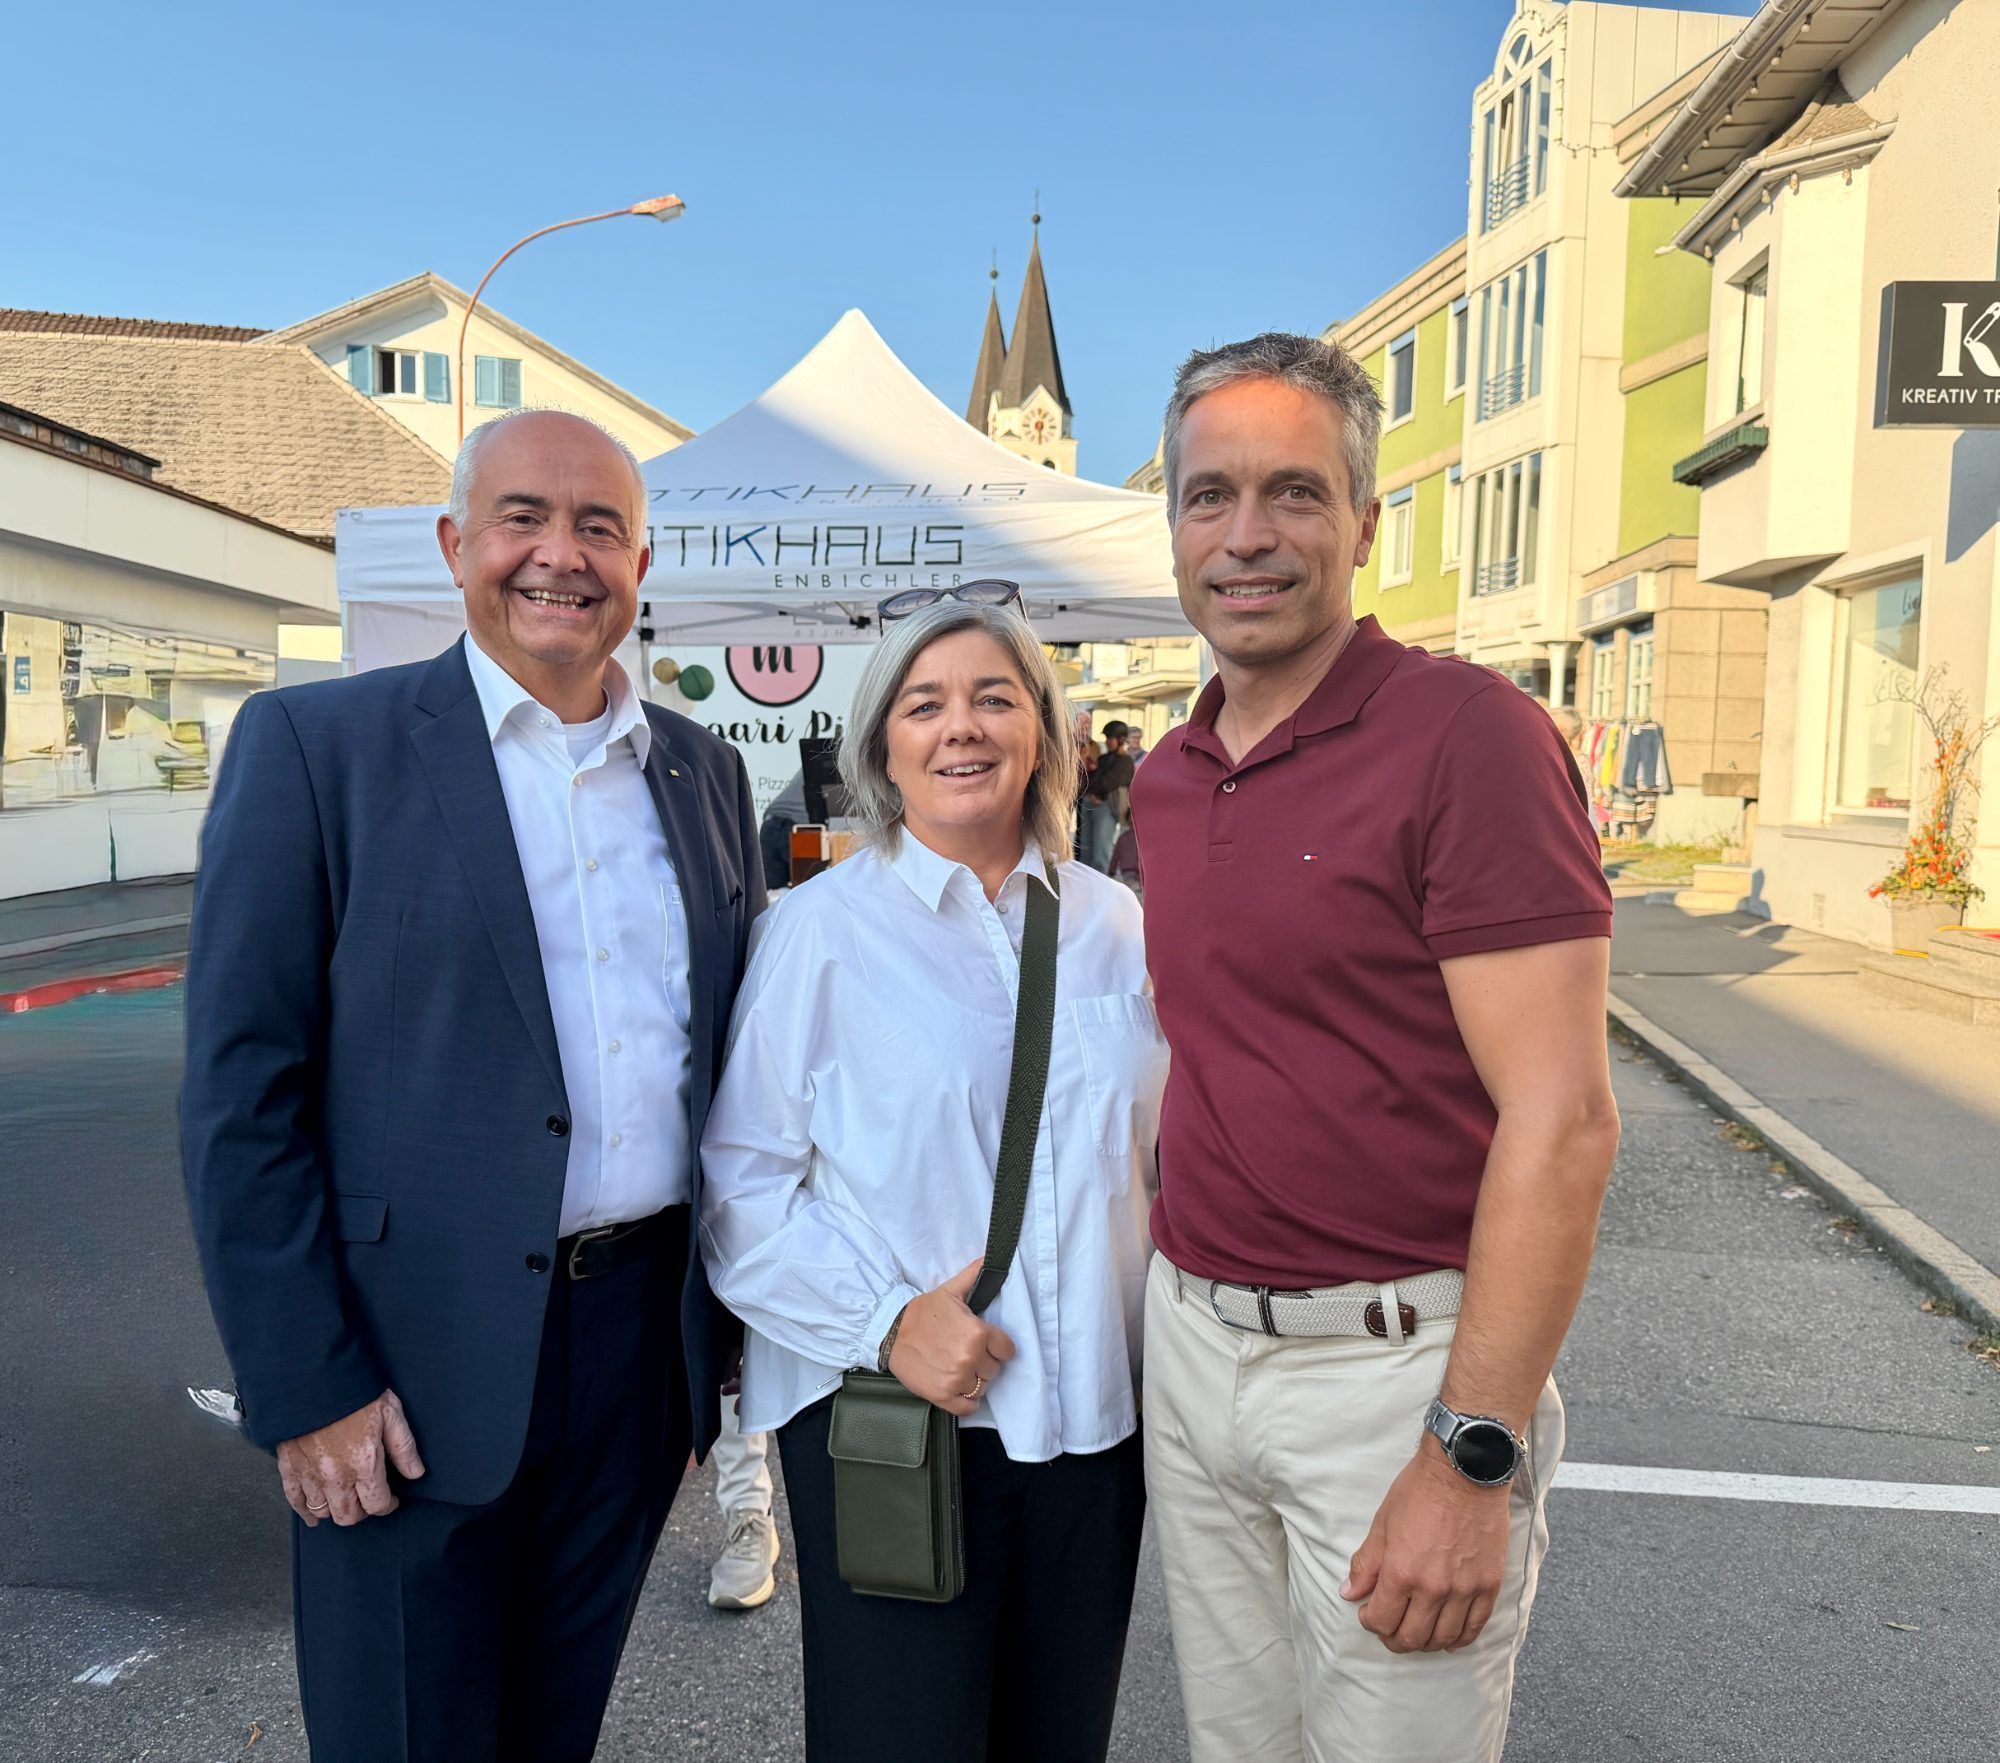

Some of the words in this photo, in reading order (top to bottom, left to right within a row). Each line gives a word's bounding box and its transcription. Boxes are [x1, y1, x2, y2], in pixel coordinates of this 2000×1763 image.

[1902, 388, 1978, 404] KREATIV
[647, 525, 964, 567] TIKHAUS
[774, 573, 962, 589] ENBICHLER
